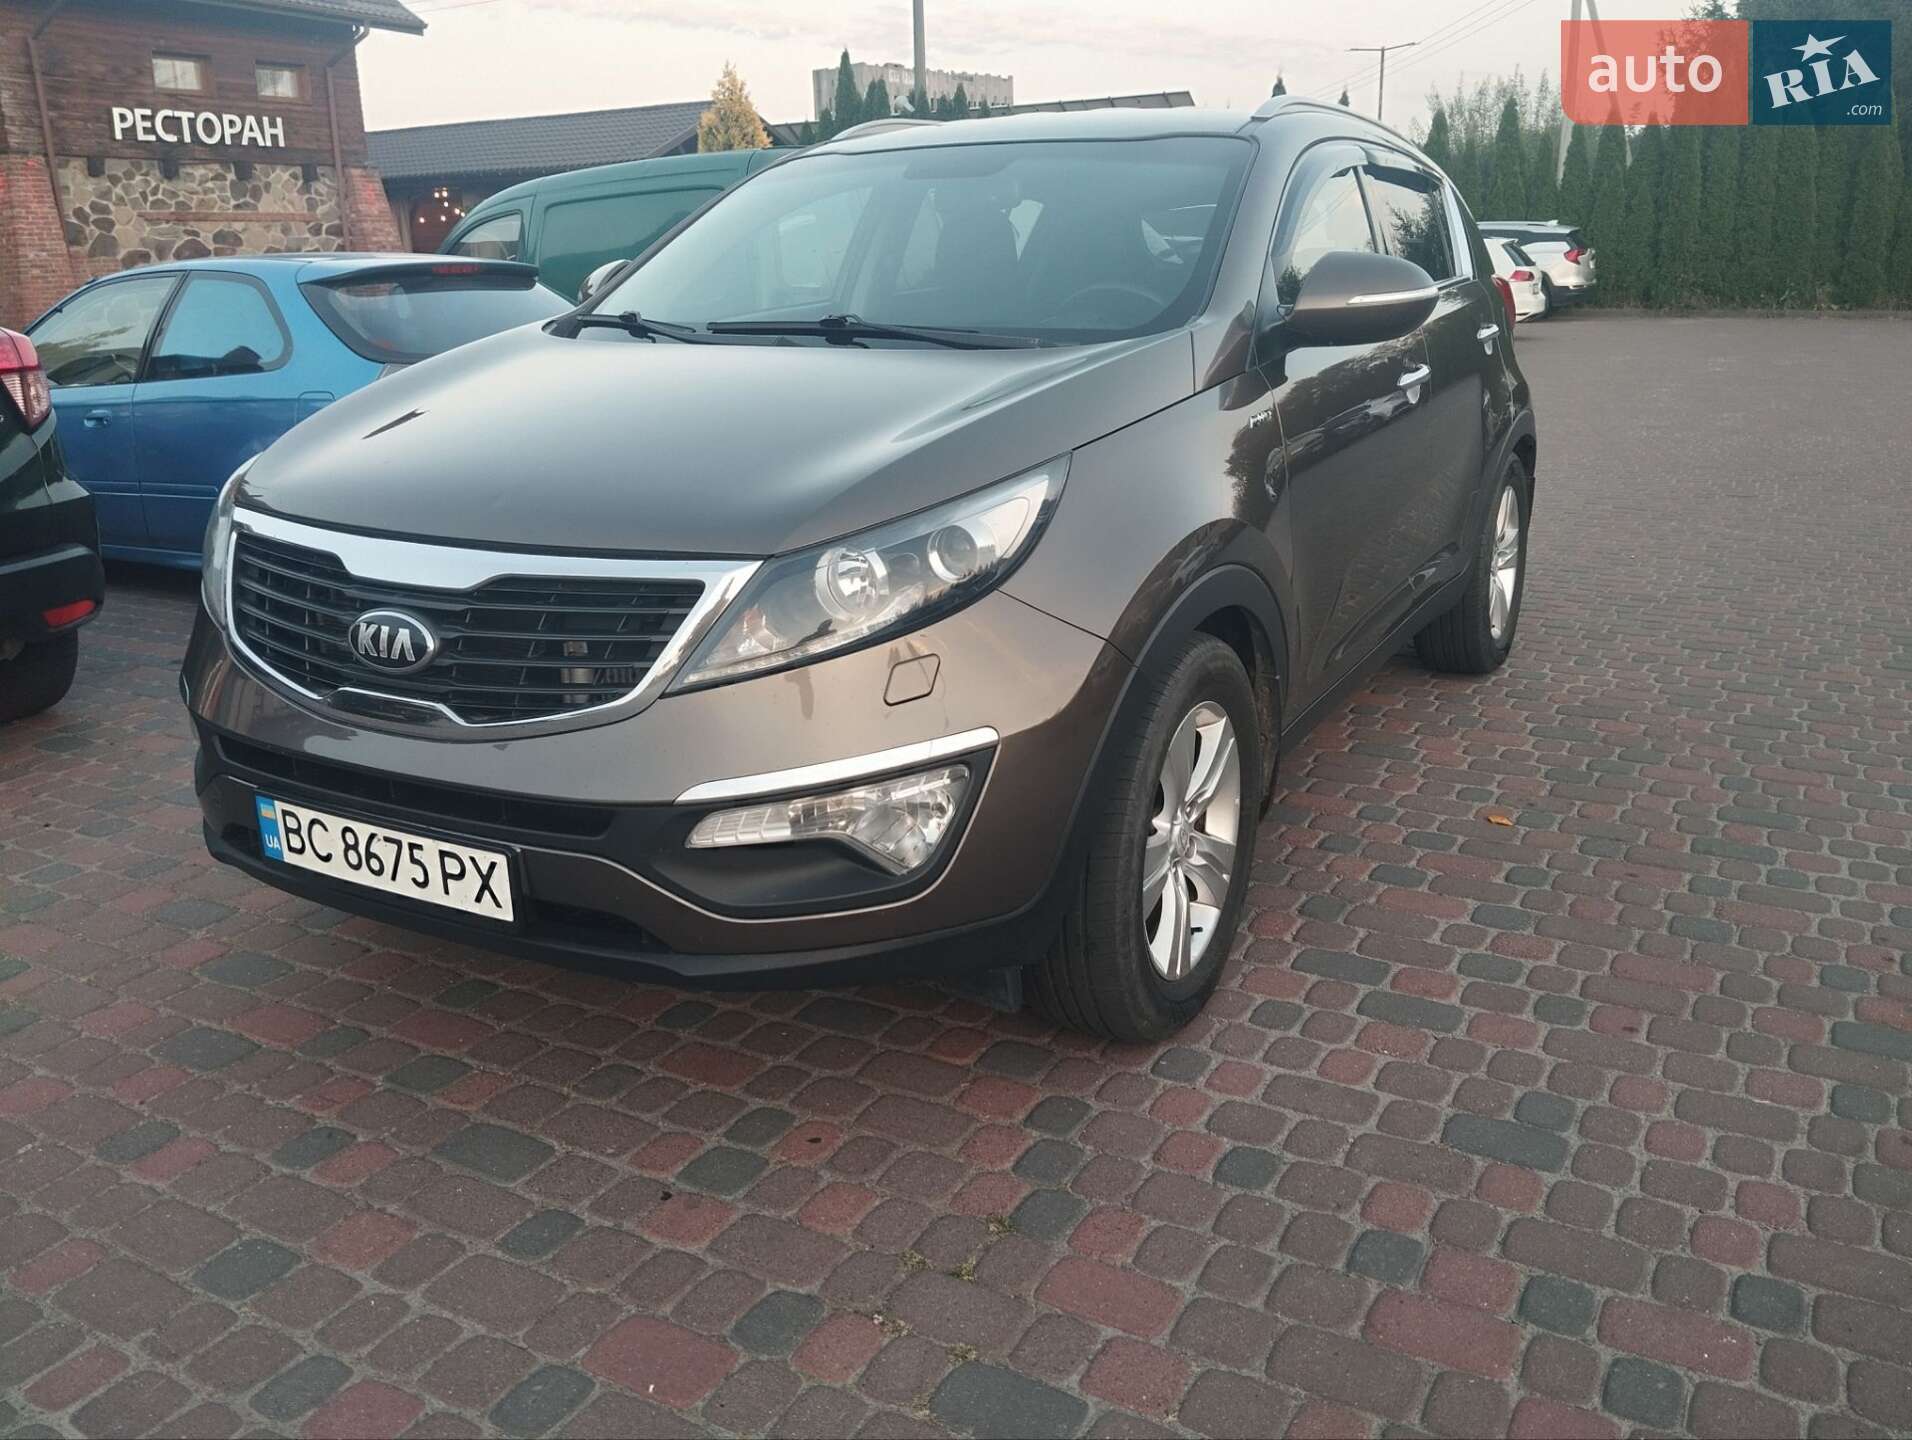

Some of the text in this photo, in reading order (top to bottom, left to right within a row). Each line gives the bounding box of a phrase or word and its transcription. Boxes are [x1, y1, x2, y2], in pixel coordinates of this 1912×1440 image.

[111, 106, 286, 148] РЕСТОРАН
[358, 621, 416, 662] KIA
[264, 833, 282, 851] UA
[281, 808, 503, 909] BC 8675 PX
